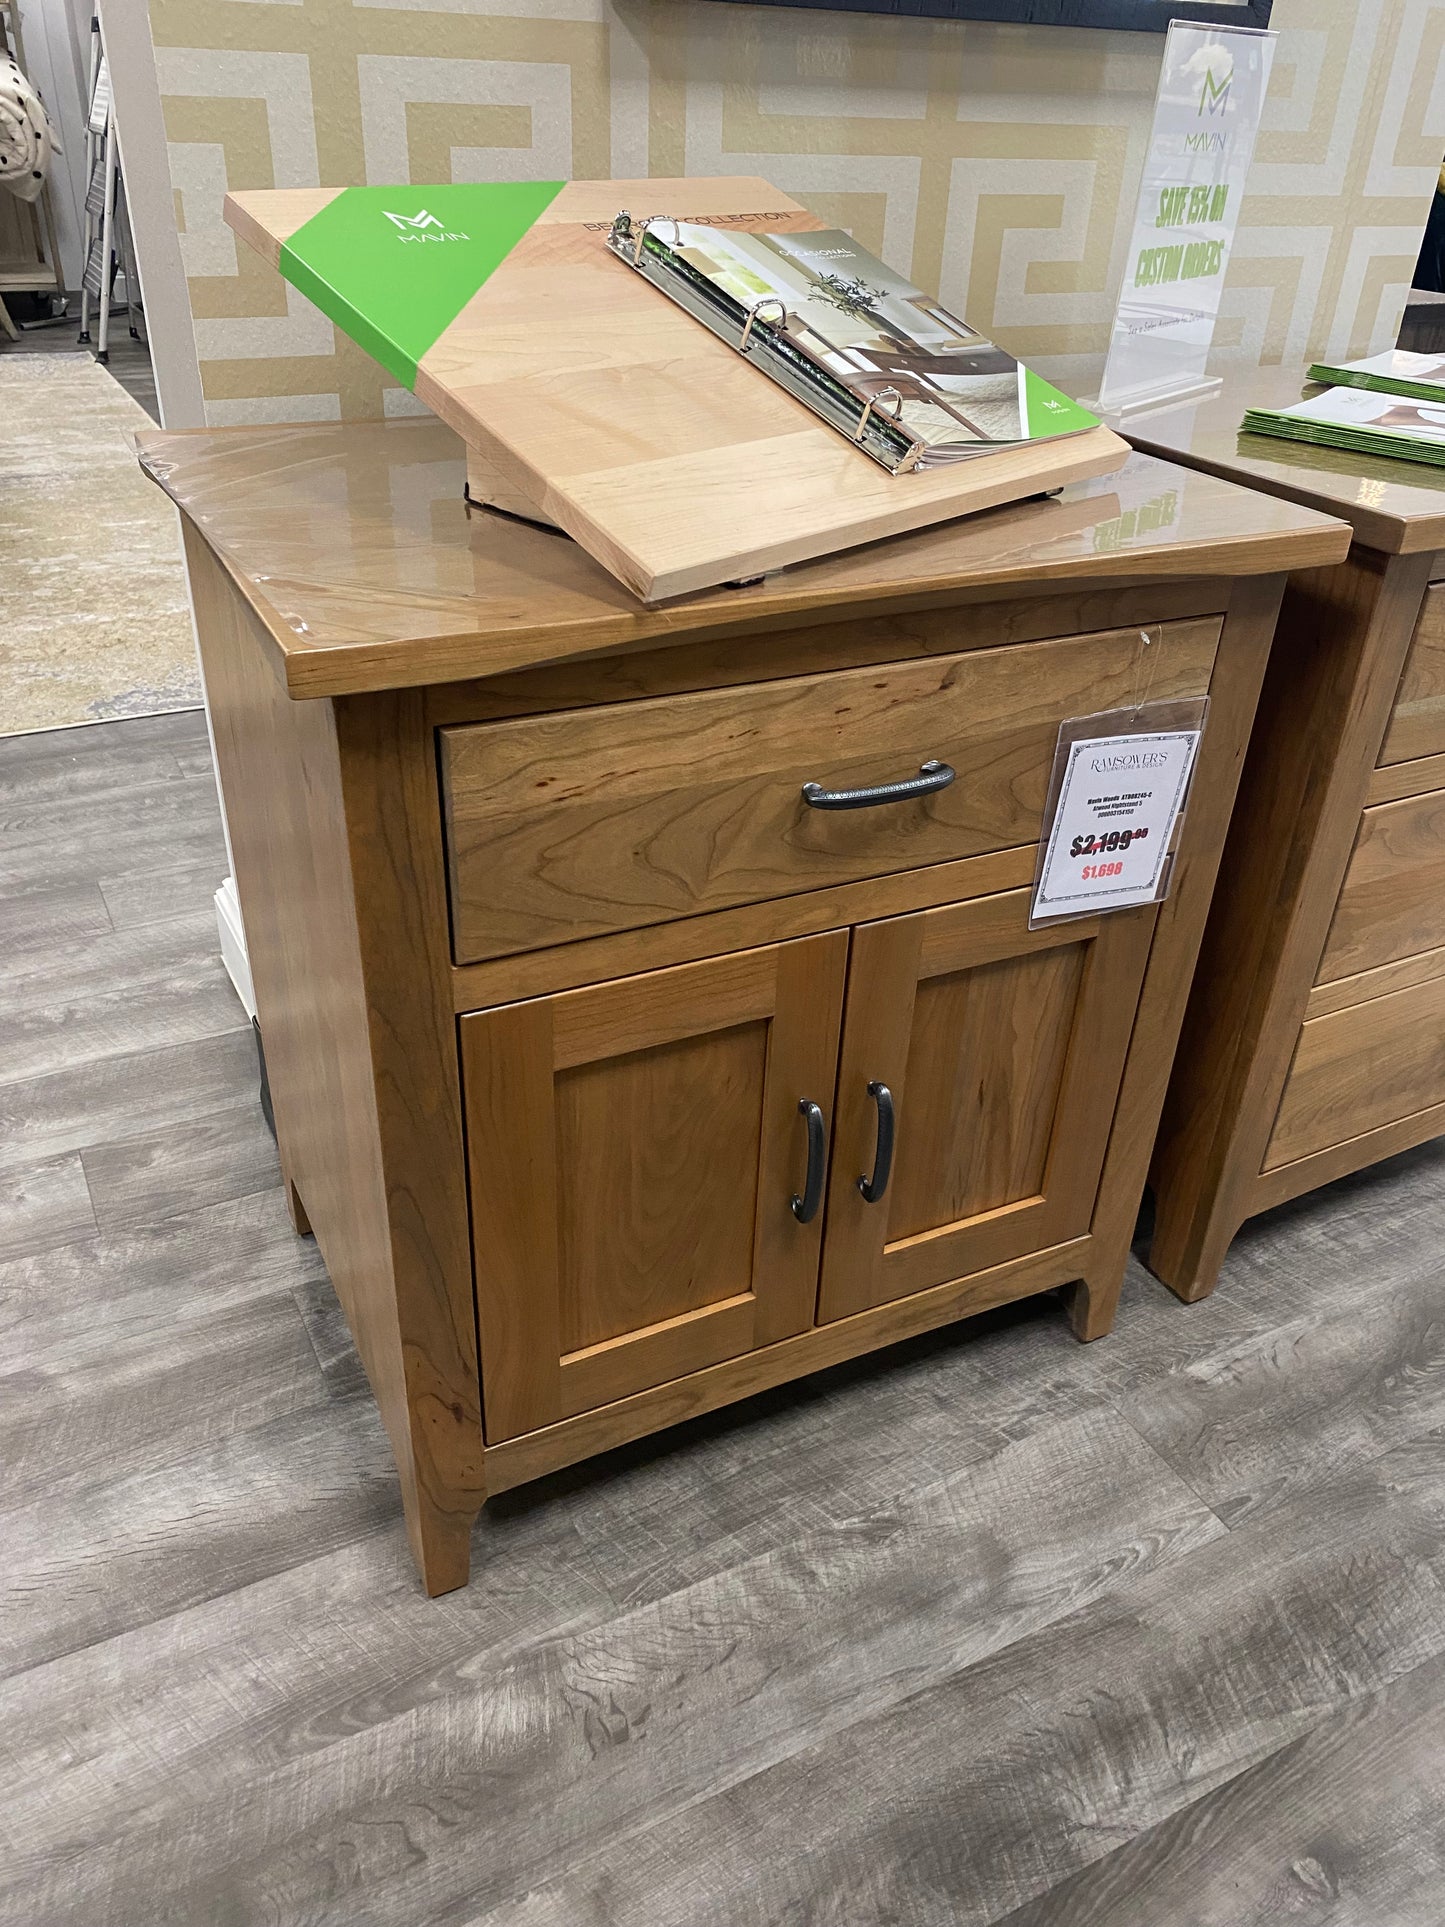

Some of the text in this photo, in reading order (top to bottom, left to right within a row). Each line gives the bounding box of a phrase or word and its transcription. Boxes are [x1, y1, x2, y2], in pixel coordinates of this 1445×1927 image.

[1184, 132, 1226, 152] MAVIN
[1155, 184, 1229, 228] SAVE 15% ON
[683, 212, 792, 226] COLLECTION
[396, 232, 470, 244] MAVIN
[778, 247, 852, 257] OCCASIONAL
[1134, 239, 1225, 288] CUSTOM ORDERS
[1090, 751, 1168, 773] RAMSOWER'S
[1103, 764, 1134, 772] FURNITURE
[1111, 800, 1138, 810] Nightstand
[1081, 861, 1124, 880] $1,698
